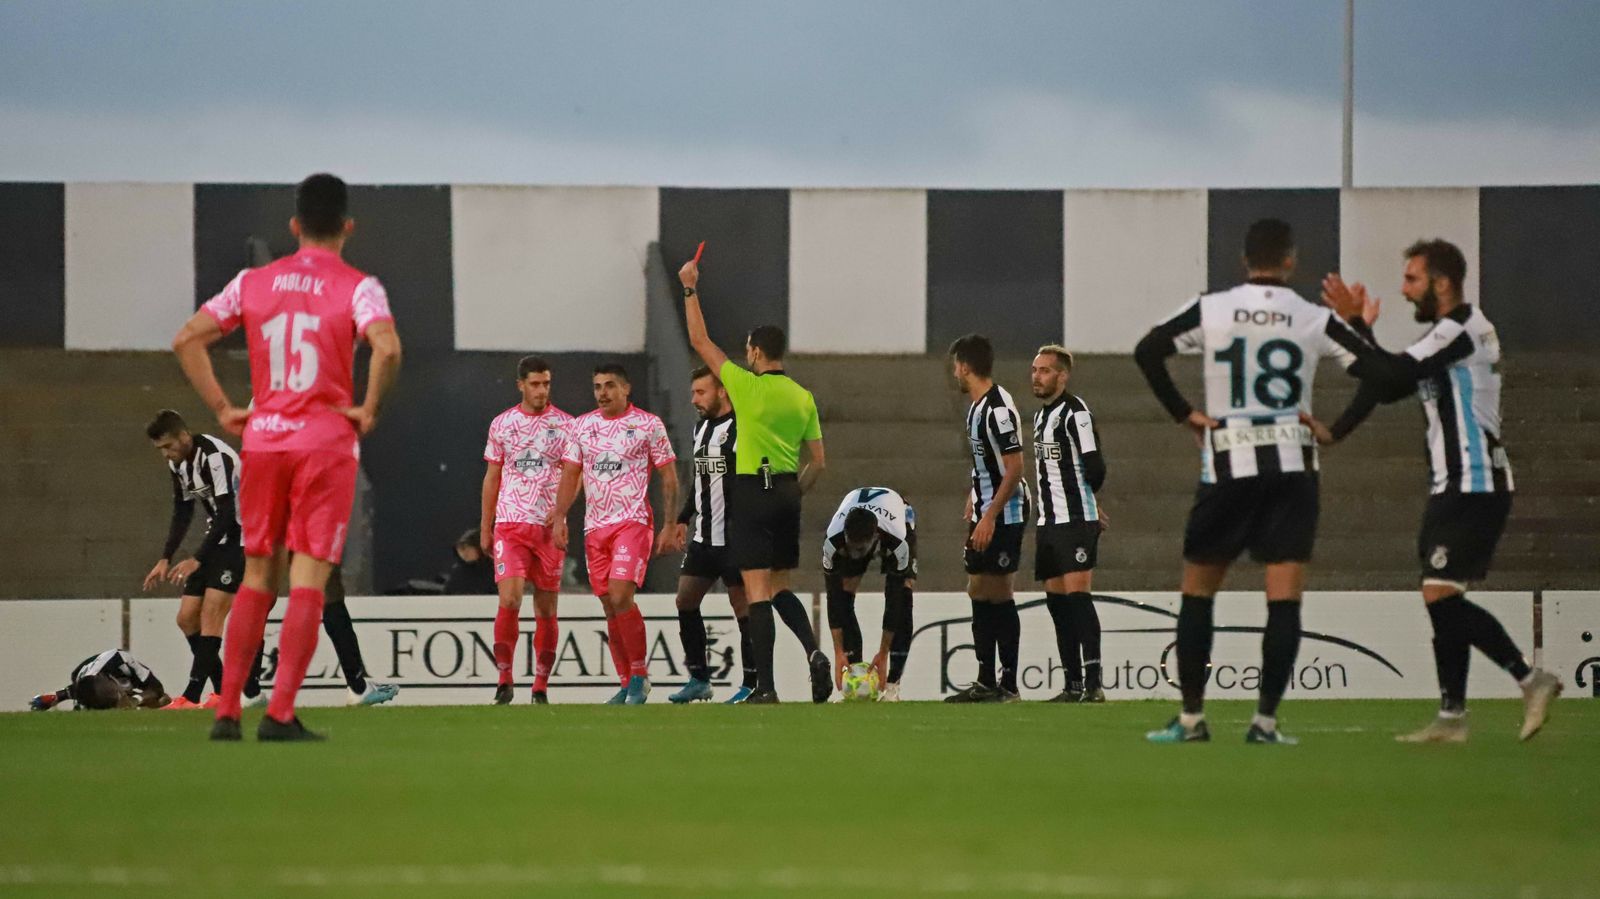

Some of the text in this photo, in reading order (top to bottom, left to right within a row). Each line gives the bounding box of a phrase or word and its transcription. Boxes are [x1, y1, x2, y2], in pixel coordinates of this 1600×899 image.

[272, 273, 312, 292] PABLO
[1234, 309, 1292, 328] DOPI
[260, 312, 320, 393] 15
[1214, 336, 1303, 410] 18
[593, 462, 620, 471] DERBY
[695, 460, 727, 475] TUS
[495, 540, 504, 558] 9
